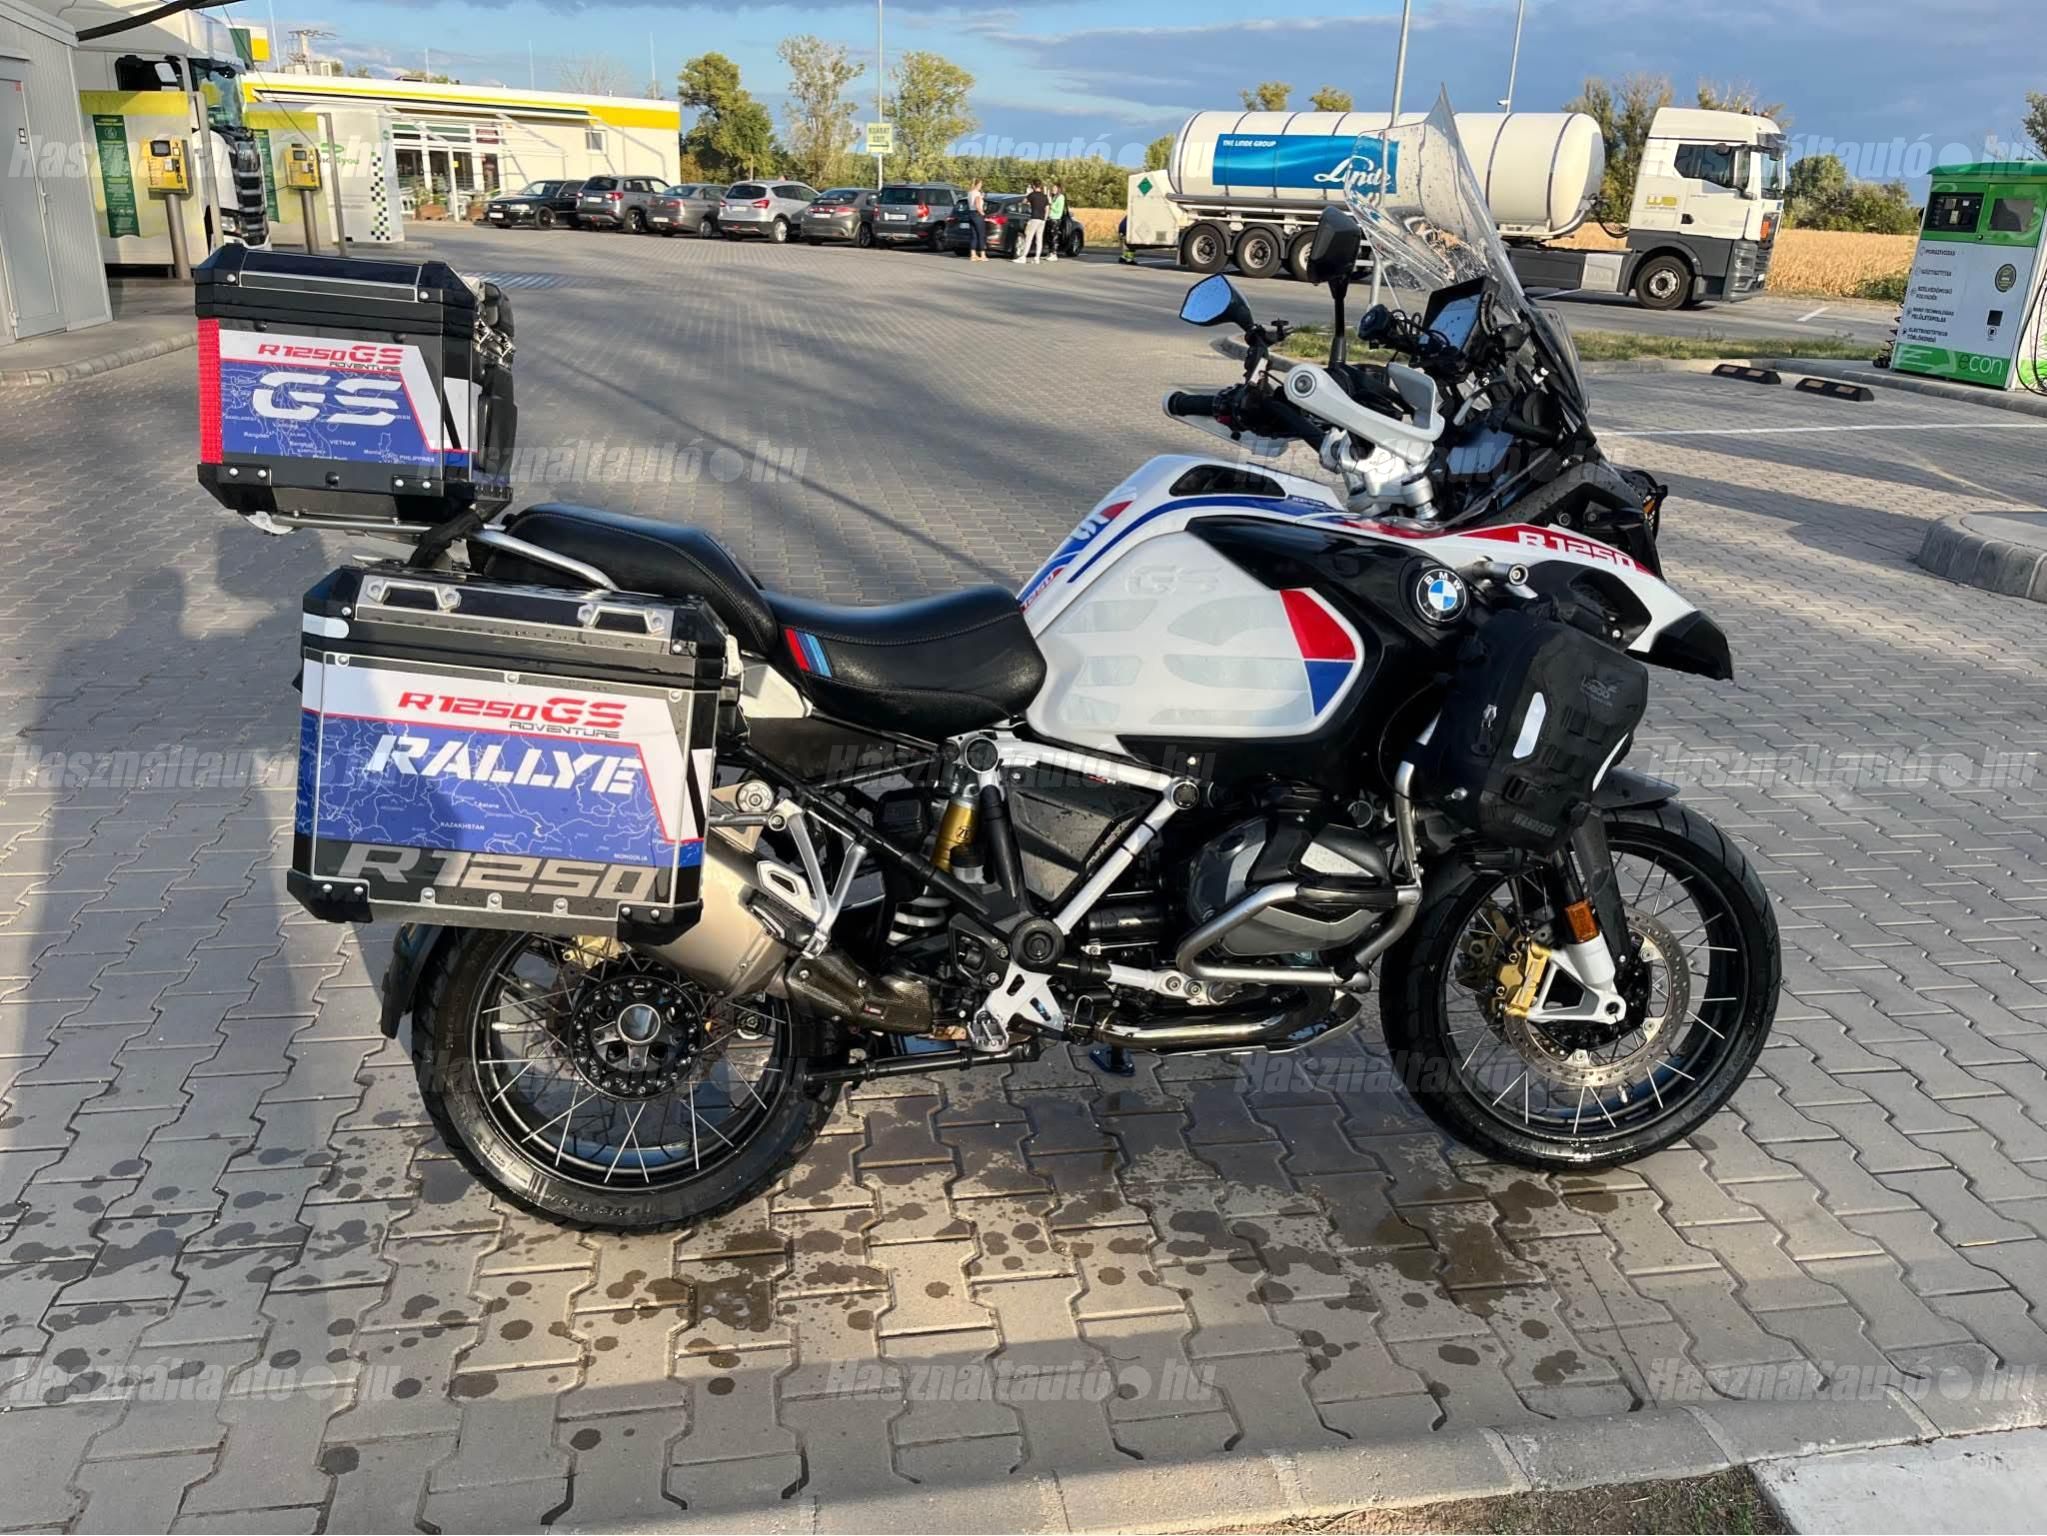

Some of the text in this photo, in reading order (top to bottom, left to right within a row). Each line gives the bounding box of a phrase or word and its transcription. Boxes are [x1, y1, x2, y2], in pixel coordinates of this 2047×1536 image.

[1223, 140, 1277, 148] THE LINDE GROUP
[329, 361, 401, 372] ADVENTURE
[1958, 353, 2003, 376] econ
[253, 371, 402, 426] GS
[330, 439, 356, 447] VIETNAM
[1424, 572, 1462, 590] BMW
[509, 721, 620, 740] ADVENTURE
[366, 735, 645, 795] RALLYE
[440, 822, 485, 831] KAZAKHSTAN
[614, 853, 648, 861] MONGOLIA
